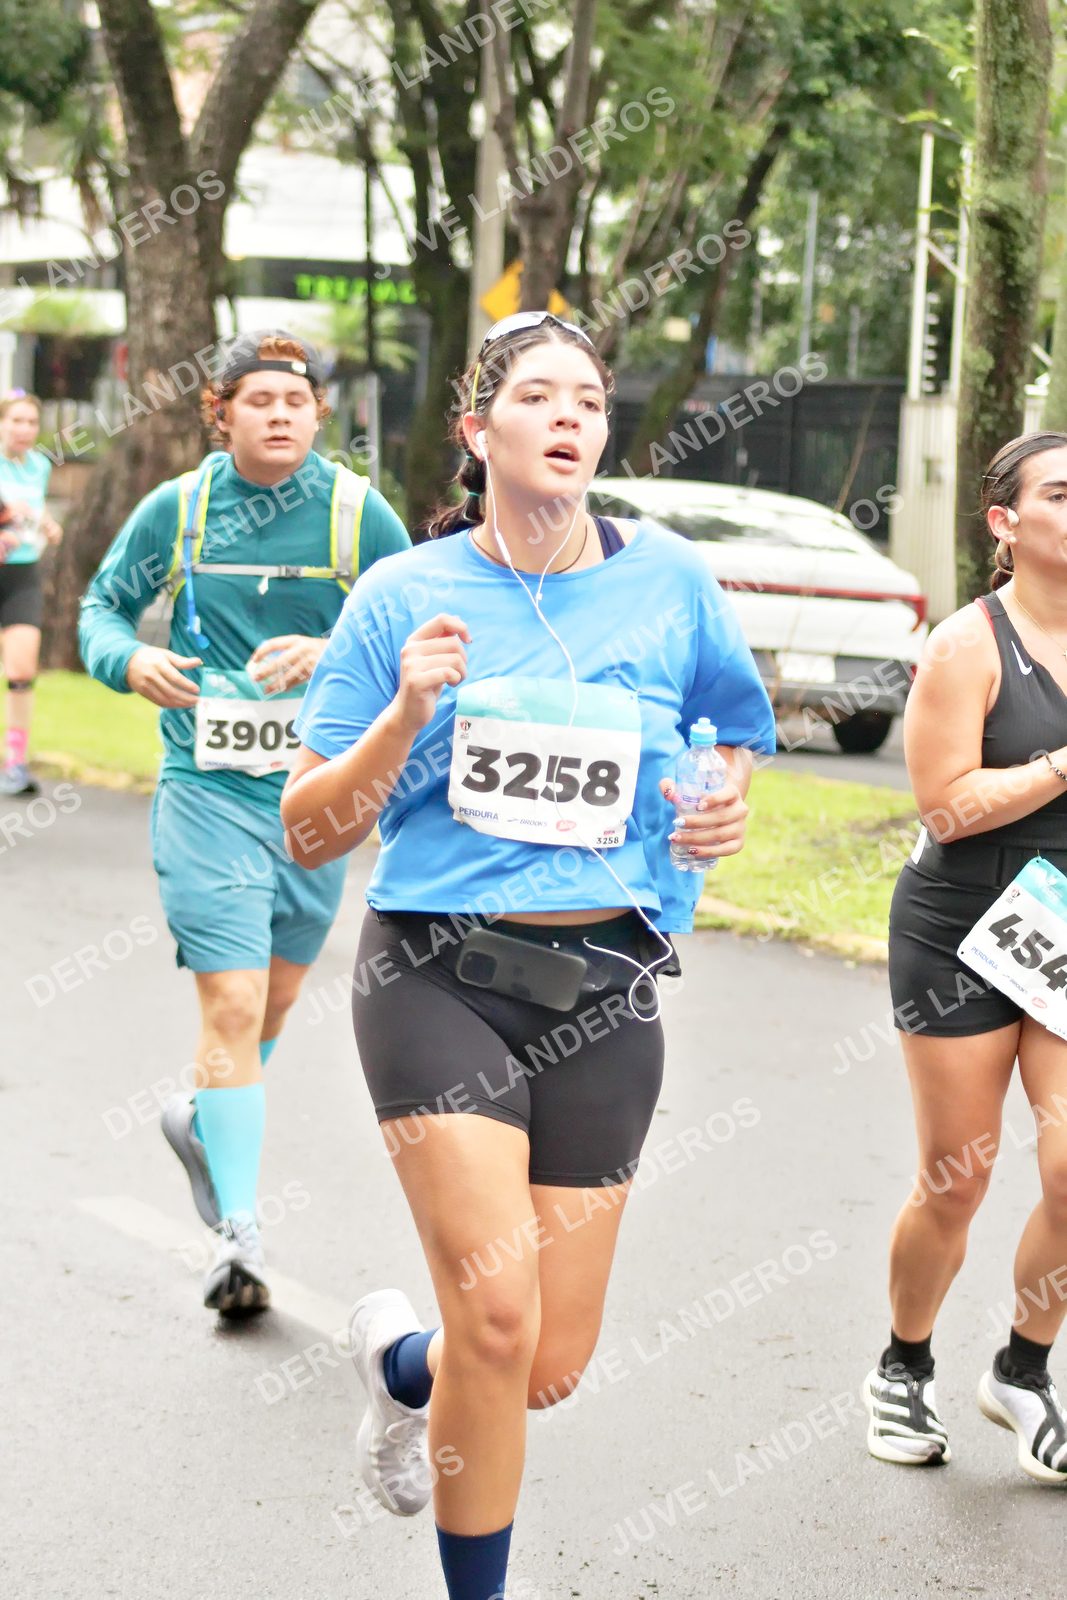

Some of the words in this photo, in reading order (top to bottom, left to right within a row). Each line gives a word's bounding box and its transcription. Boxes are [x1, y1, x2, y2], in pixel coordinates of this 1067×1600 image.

[206, 719, 301, 751] 3909
[461, 745, 621, 807] 3258
[459, 806, 499, 820] PERDURA
[596, 837, 619, 845] 3258
[970, 946, 998, 970] PERDURA
[988, 913, 1067, 992] 454
